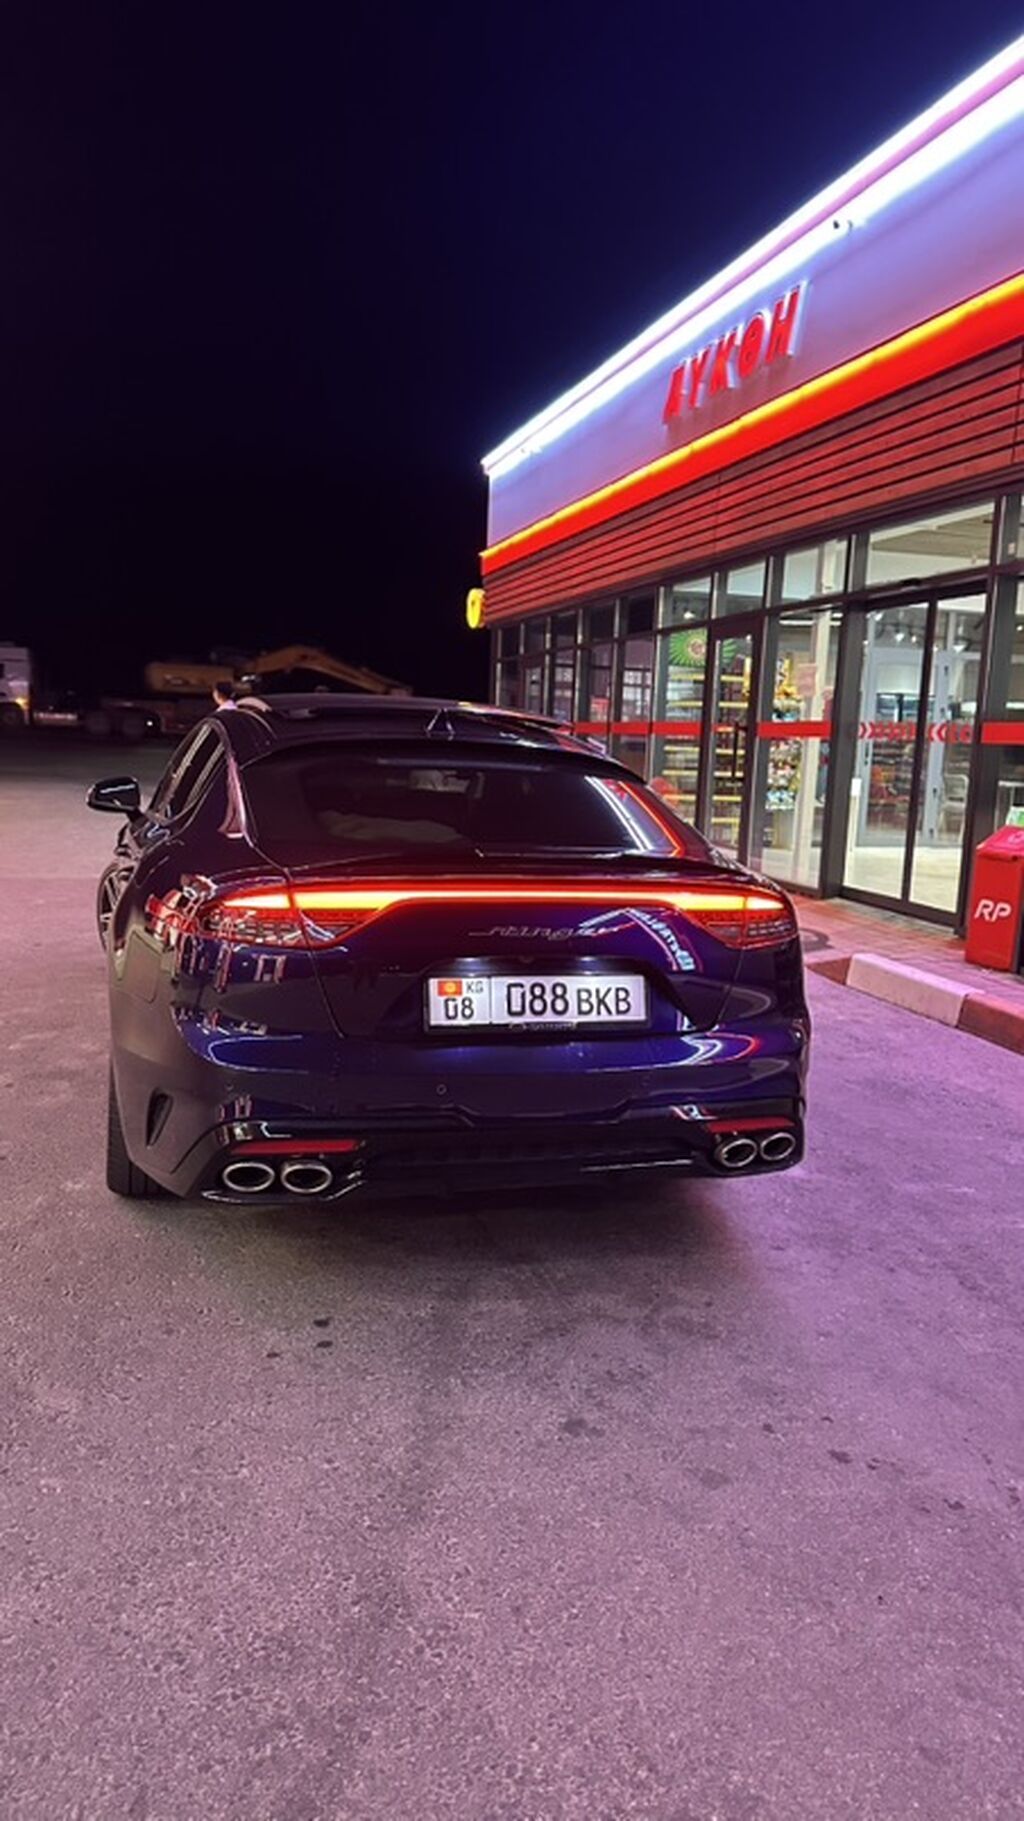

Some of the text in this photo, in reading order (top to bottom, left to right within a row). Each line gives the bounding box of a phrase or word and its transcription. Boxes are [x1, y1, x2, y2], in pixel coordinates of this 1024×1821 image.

[973, 898, 1012, 923] RP
[465, 980, 484, 994] KG
[444, 997, 475, 1020] 08
